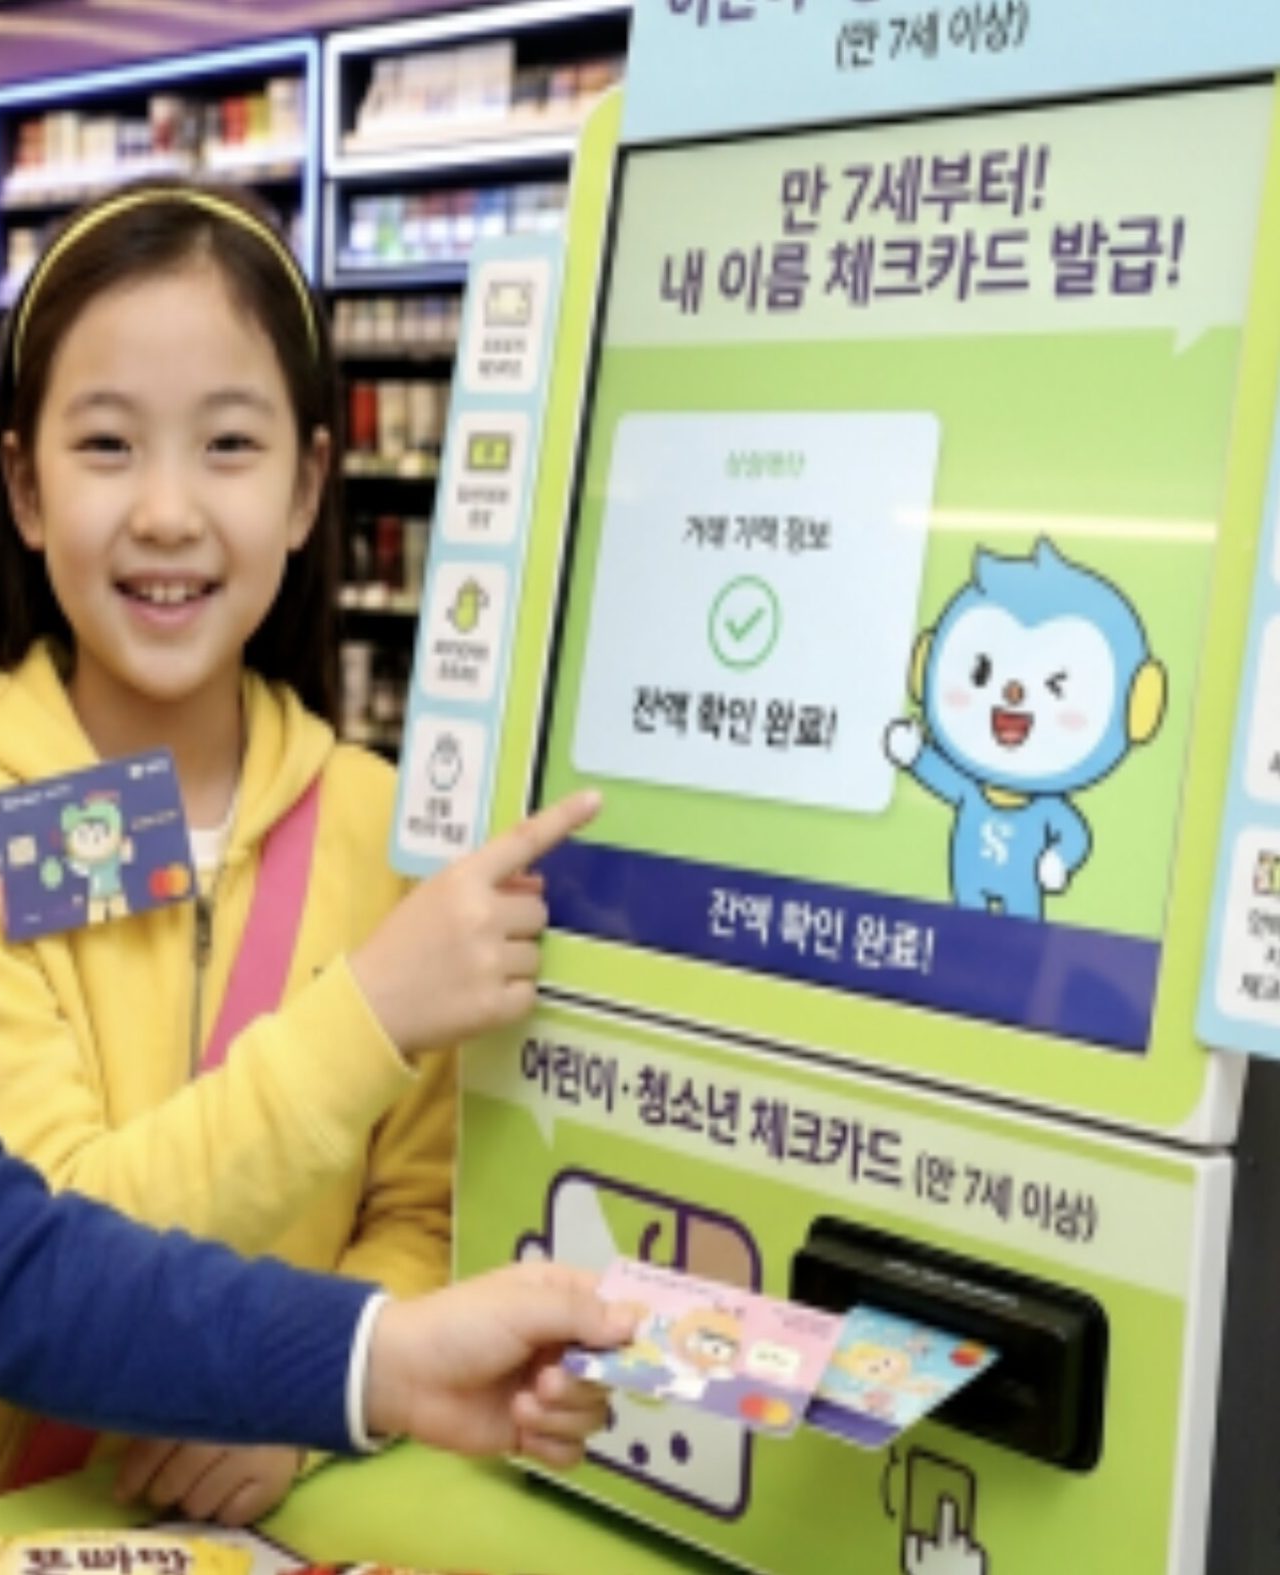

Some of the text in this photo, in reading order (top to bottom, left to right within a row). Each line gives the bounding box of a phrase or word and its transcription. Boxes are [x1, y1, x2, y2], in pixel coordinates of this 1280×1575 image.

[834, 1, 1030, 69] (만 7세 이상)
[781, 145, 1051, 233] 만 7세부터!
[660, 215, 1187, 315] 내 이름 체크카드 발급!
[632, 685, 838, 753] 잔액 확인 완료!
[708, 888, 935, 975] 잔액 확인 완료!
[749, 1098, 904, 1188] 체크카드
[915, 1151, 957, 1204] (만
[963, 1163, 1013, 1221] 7세
[1022, 1188, 1097, 1243] 이상)
